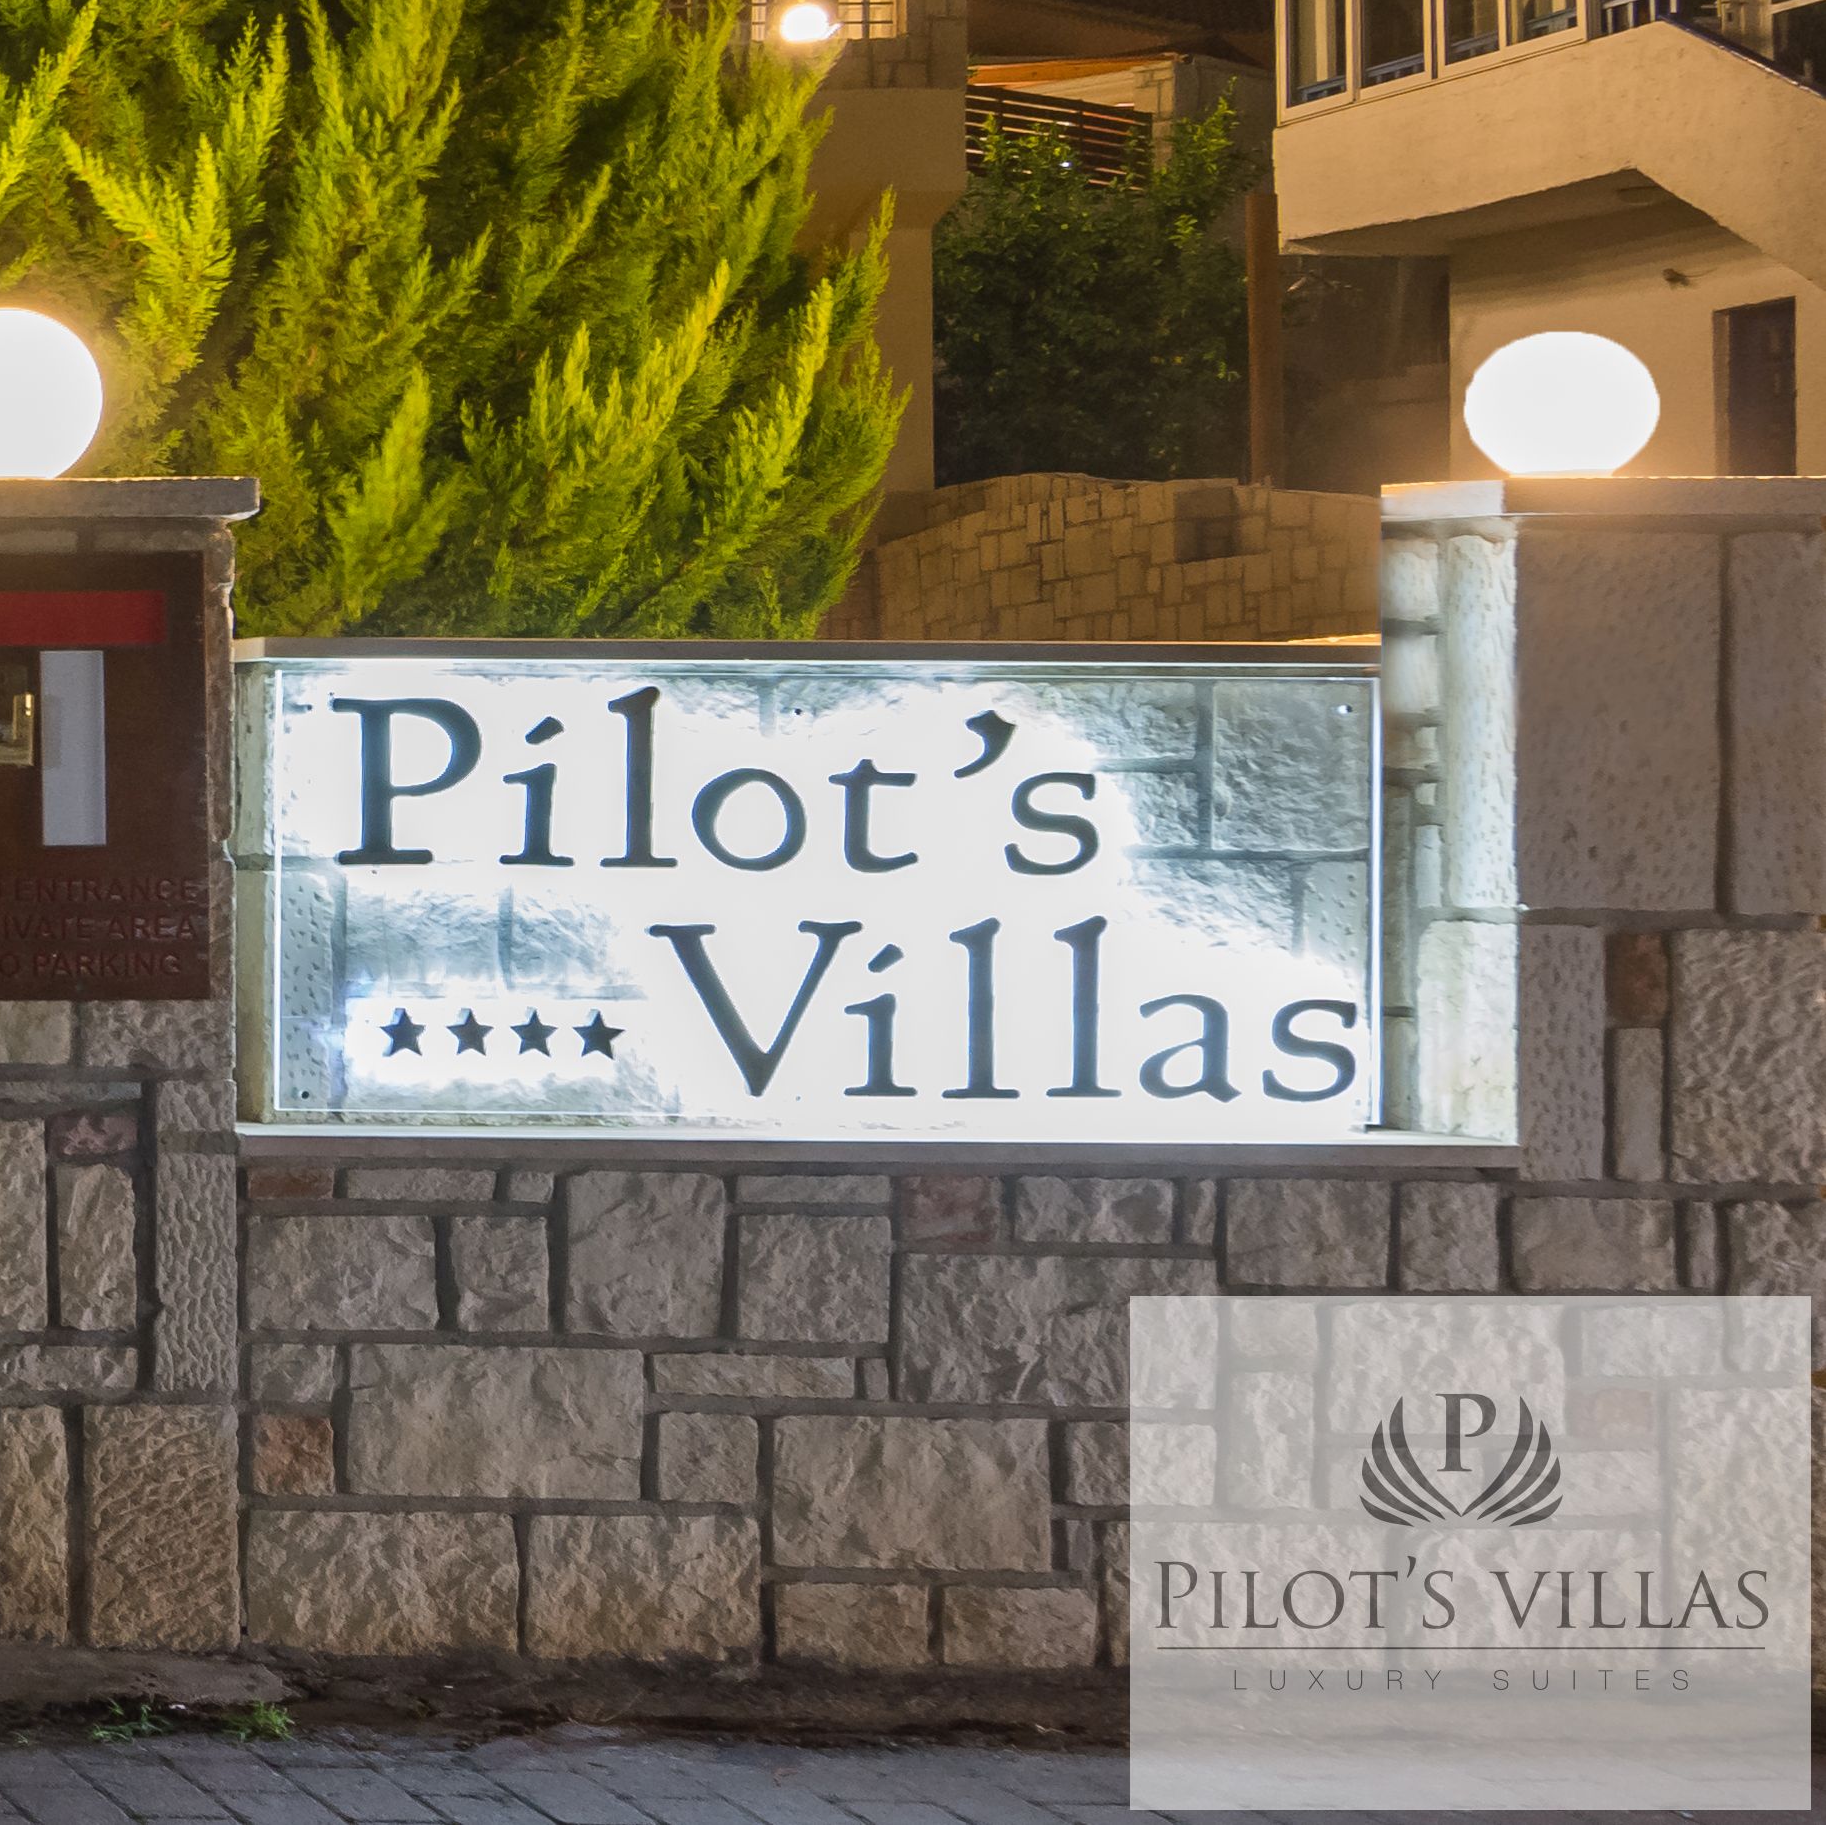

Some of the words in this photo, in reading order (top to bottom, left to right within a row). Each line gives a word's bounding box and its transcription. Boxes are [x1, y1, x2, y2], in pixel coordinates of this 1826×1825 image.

[330, 686, 1100, 876] Pilot's
[14, 877, 200, 903] ENTRANCE
[107, 917, 198, 941] AREA
[31, 952, 181, 978] PARKING
[646, 915, 1357, 1104] Villas
